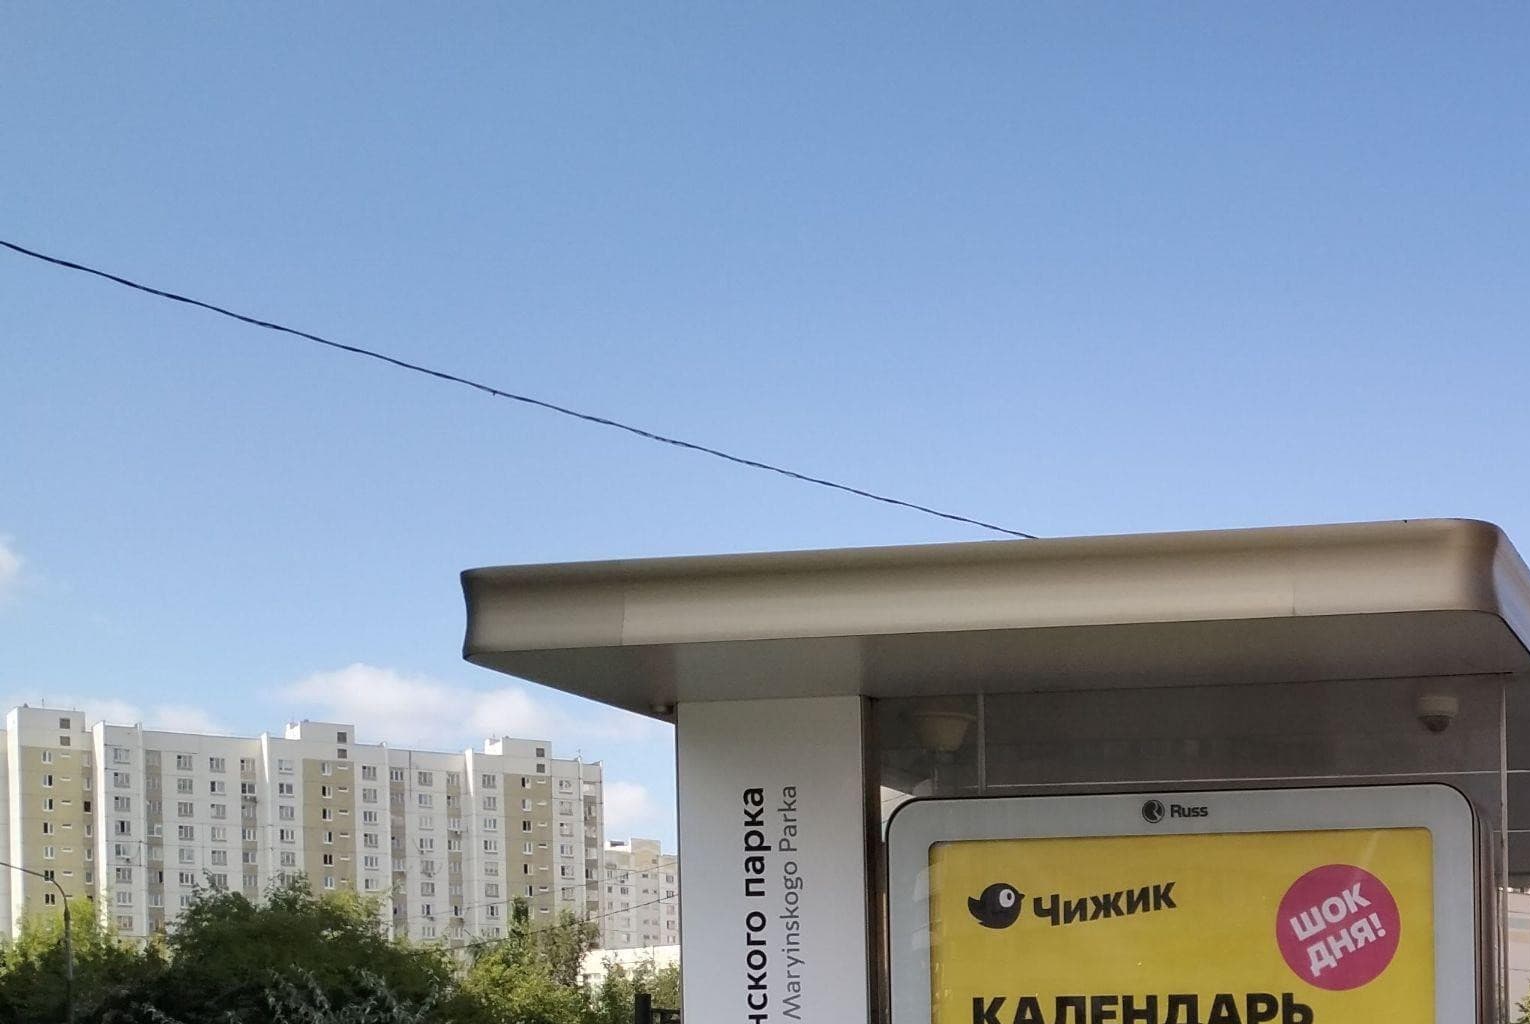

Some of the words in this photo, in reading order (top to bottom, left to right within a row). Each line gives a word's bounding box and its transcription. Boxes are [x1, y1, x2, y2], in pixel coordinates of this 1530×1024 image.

[743, 787, 772, 897] парка
[777, 786, 797, 852] Parka
[1169, 803, 1209, 819] Russ
[779, 861, 805, 1020] Maryinskogo
[1289, 882, 1372, 942] ШОК
[1305, 915, 1387, 977] ДНЯ!
